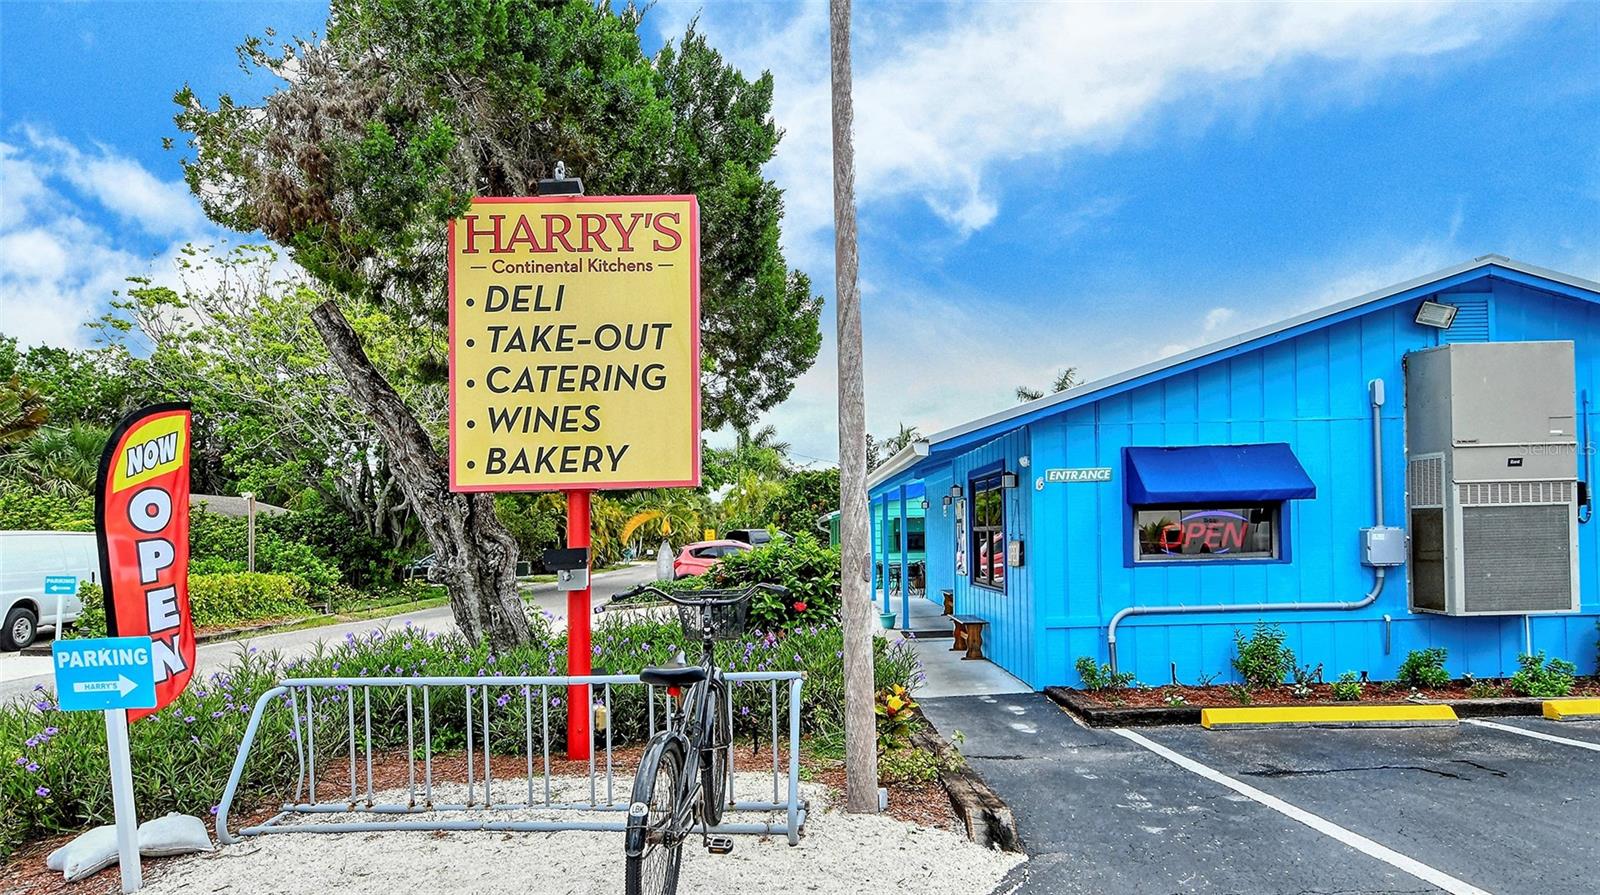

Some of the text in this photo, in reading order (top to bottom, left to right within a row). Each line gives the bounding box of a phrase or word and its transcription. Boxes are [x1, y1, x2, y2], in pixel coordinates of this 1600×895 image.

[462, 212, 682, 254] HARRY'S
[492, 257, 653, 274] Continental Kitchens
[484, 284, 565, 313] DELI
[487, 323, 672, 353] TAKE-OUT
[486, 363, 667, 394] CATERING
[487, 404, 601, 434] WINES
[125, 432, 178, 478] NOW
[485, 444, 630, 475] BAKERY
[1049, 468, 1111, 481] ENTRANCE
[1160, 521, 1249, 550] OPEN
[128, 487, 187, 686] OPEN
[57, 648, 149, 669] PARKING
[84, 682, 118, 691] HARRY'S
